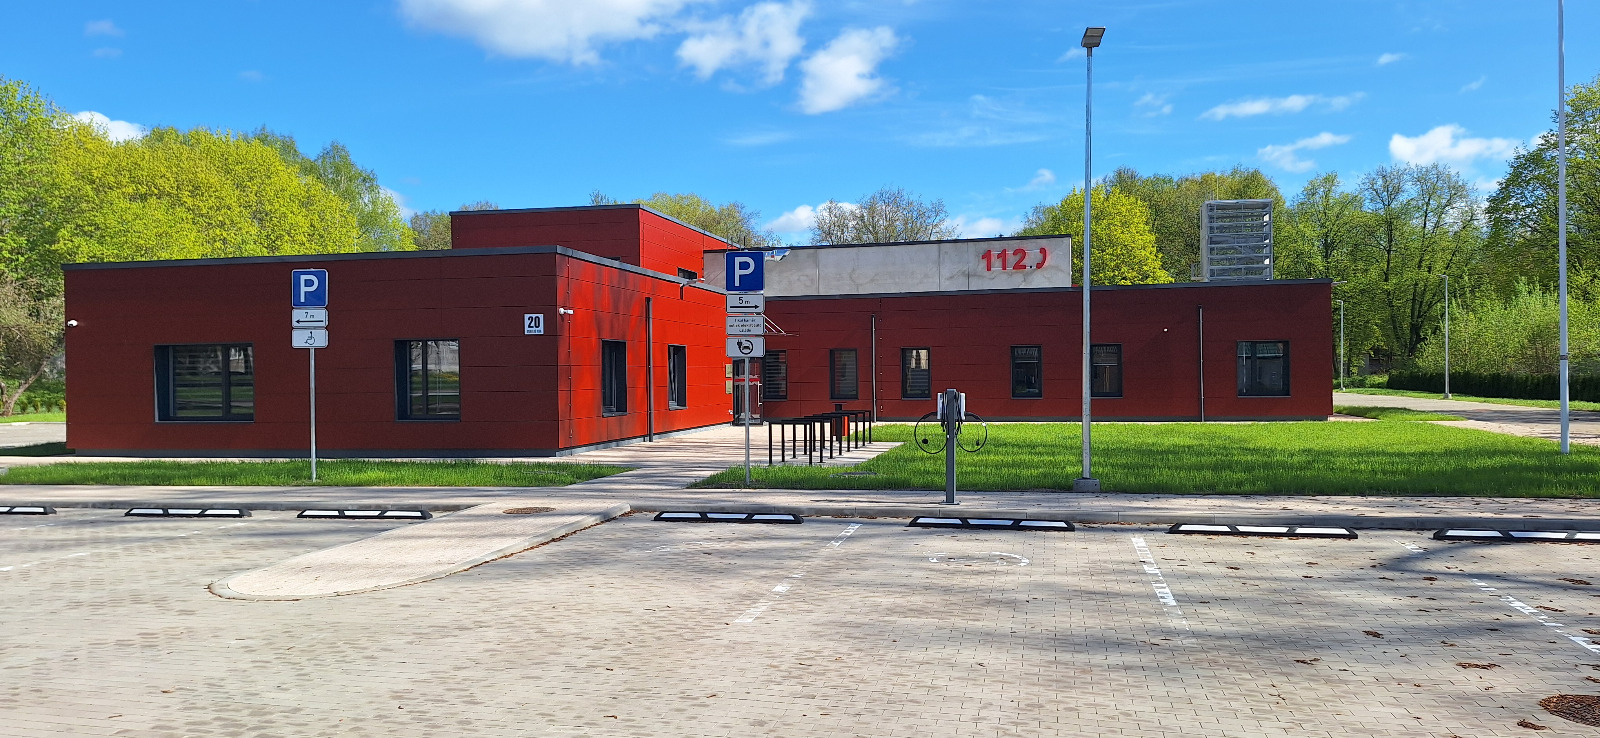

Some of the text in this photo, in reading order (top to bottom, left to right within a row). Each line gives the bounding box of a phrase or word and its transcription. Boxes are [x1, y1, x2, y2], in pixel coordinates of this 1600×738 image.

[734, 256, 755, 287] P
[299, 274, 319, 303] P
[738, 296, 744, 305] 5
[304, 311, 309, 319] 7
[527, 315, 541, 329] 20
